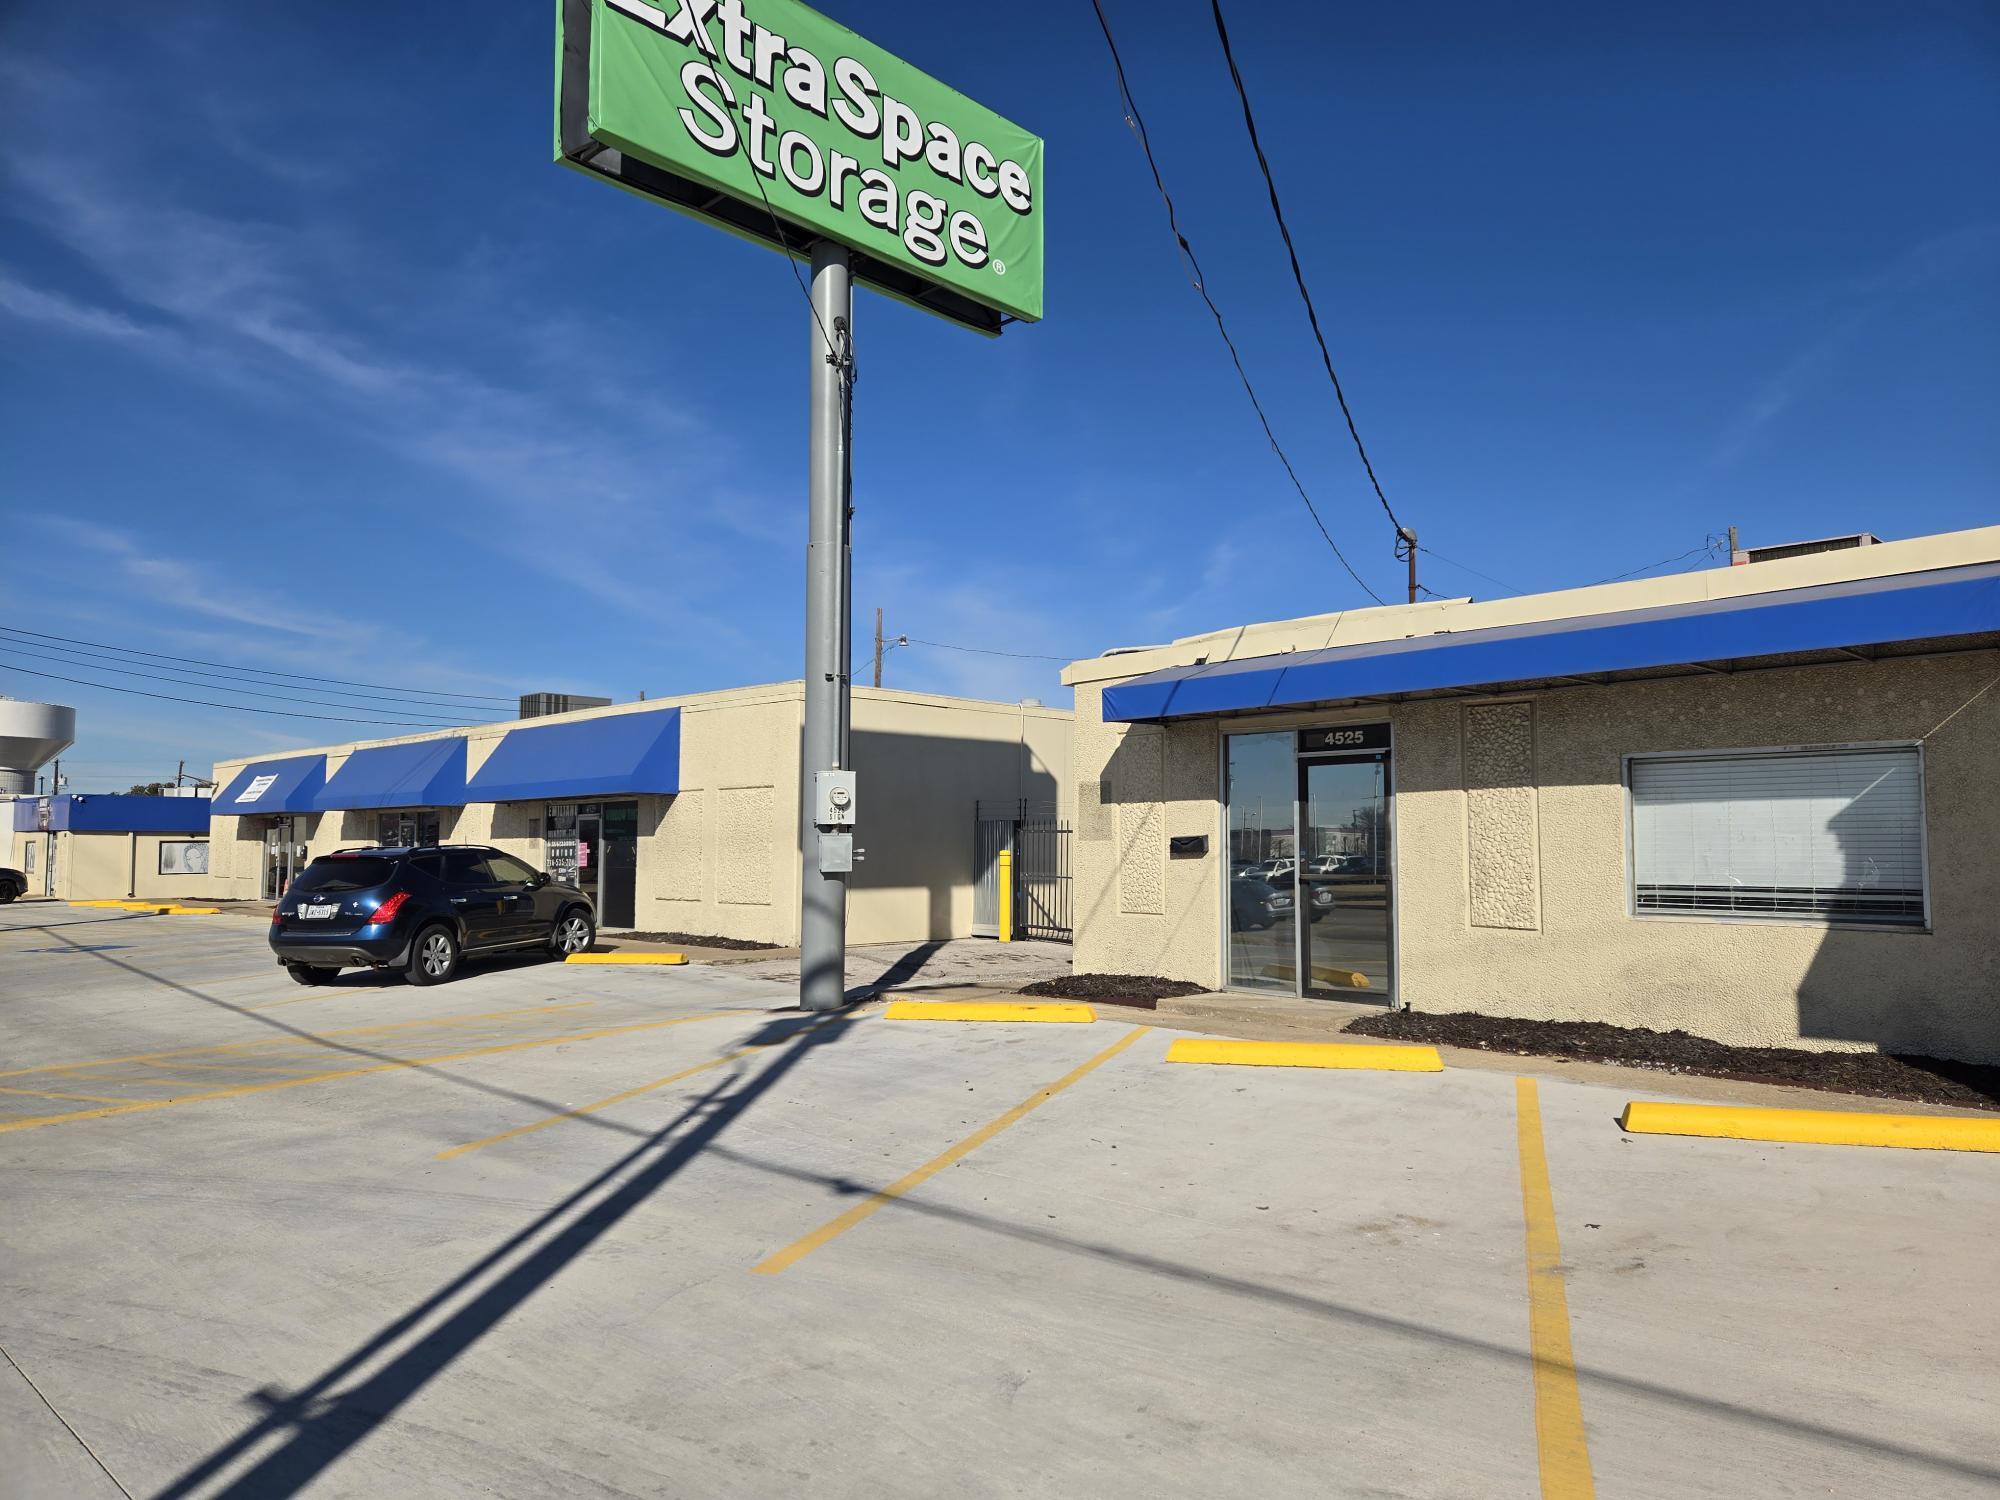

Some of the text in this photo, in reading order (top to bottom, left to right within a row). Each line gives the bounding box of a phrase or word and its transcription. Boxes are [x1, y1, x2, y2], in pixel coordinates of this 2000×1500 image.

[604, 0, 1032, 214] xtraSpace
[677, 60, 990, 269] Storage
[1324, 731, 1364, 745] 4525
